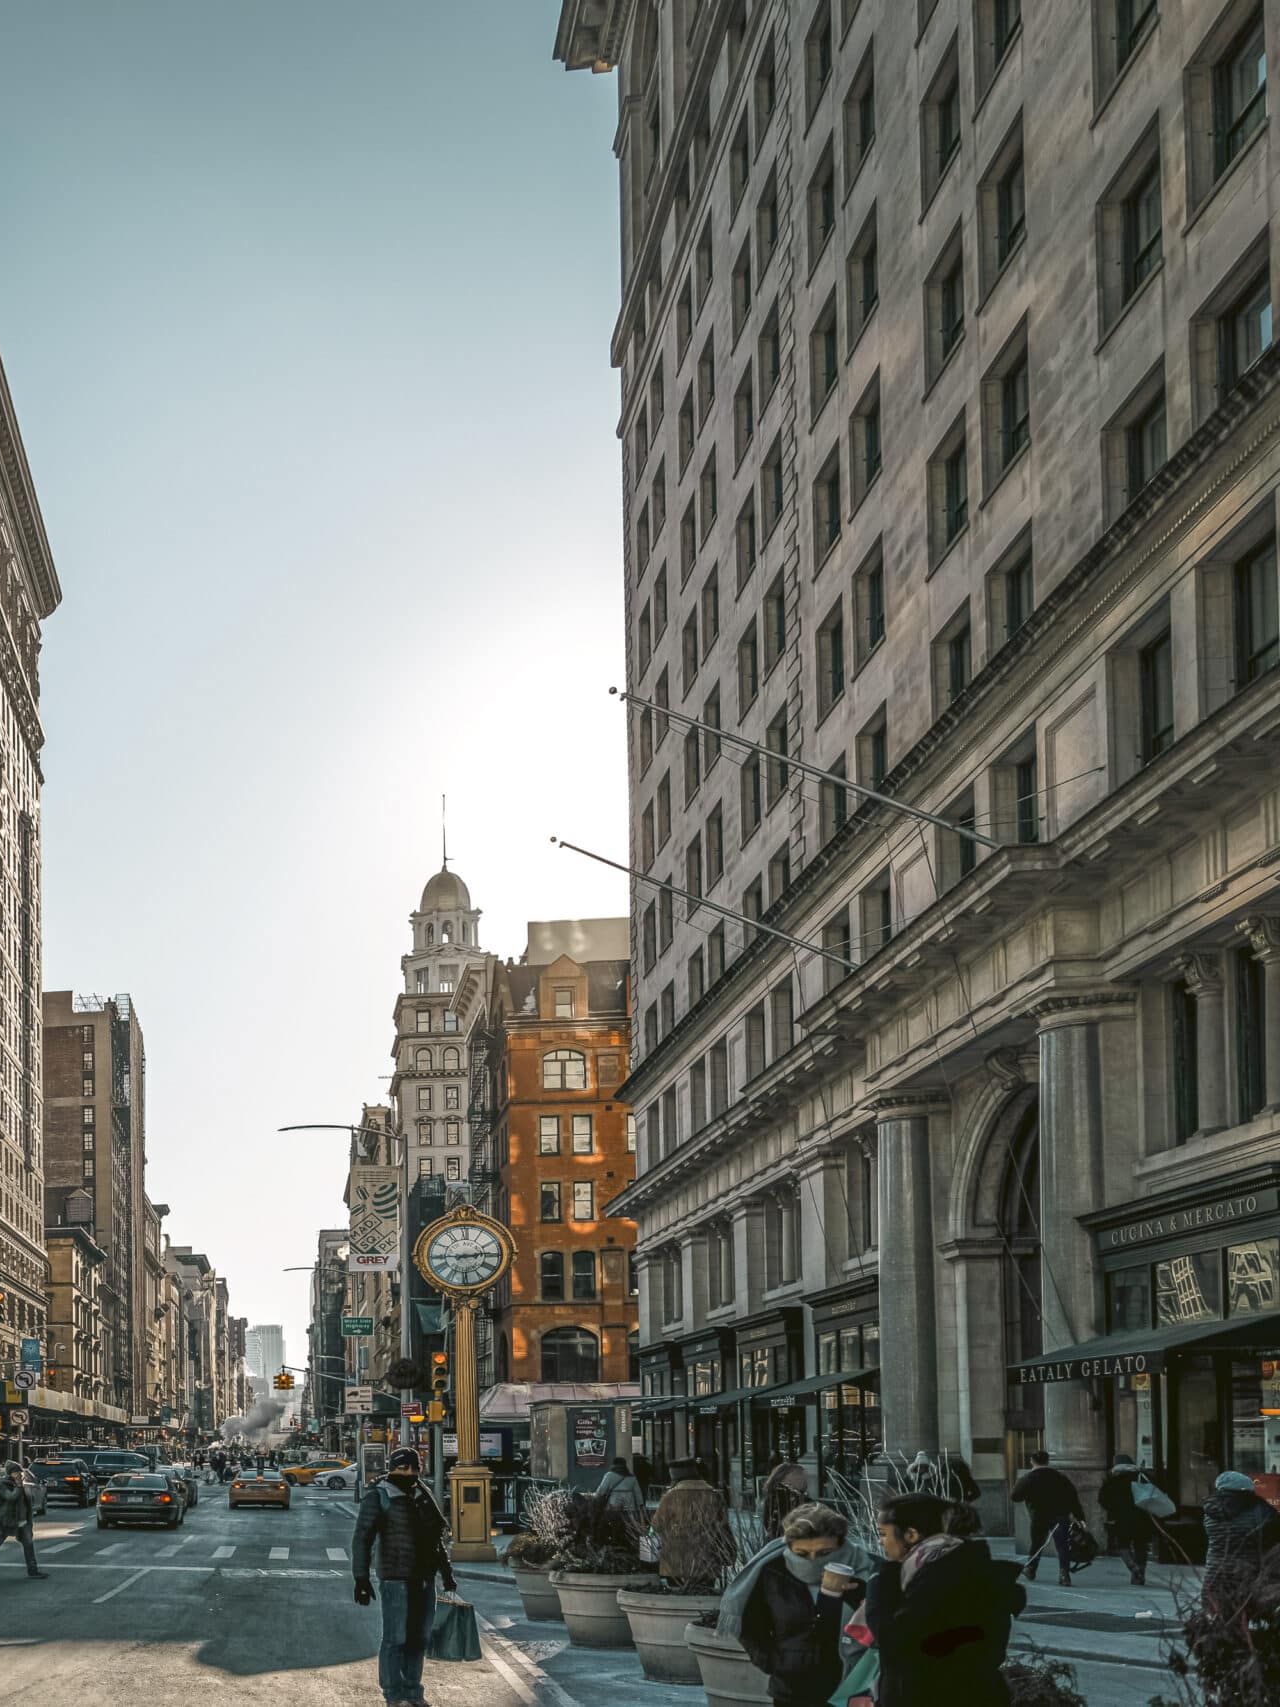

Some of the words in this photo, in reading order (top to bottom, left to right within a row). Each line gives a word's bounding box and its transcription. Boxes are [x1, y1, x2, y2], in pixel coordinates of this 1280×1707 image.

[1111, 1220, 1163, 1245] CUCINA
[1170, 1217, 1177, 1232] &
[1183, 1196, 1257, 1227] MERCATO
[356, 1255, 390, 1265] GREY
[1020, 1363, 1073, 1383] EATALY
[1081, 1355, 1146, 1377] GELATO
